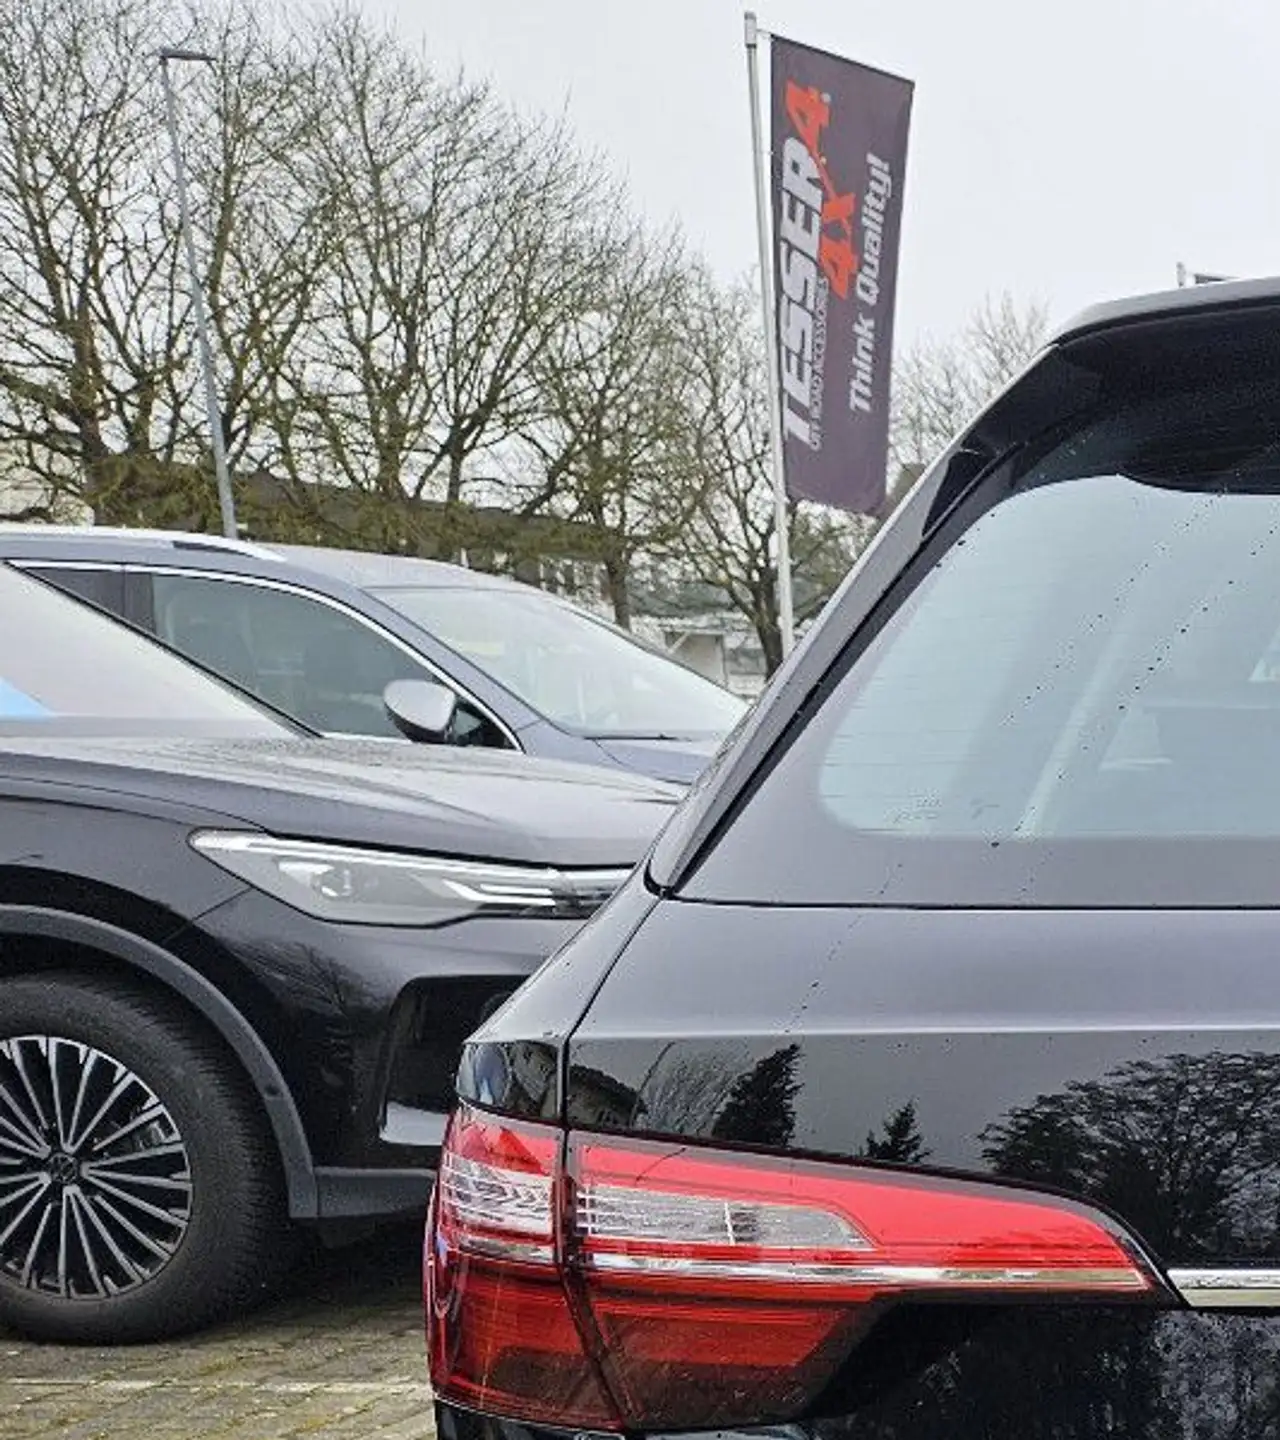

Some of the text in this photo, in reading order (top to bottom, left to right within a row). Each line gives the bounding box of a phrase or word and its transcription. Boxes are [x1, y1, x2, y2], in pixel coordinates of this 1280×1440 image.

[780, 137, 824, 446] TESSER
[850, 152, 893, 413] Think Quality!
